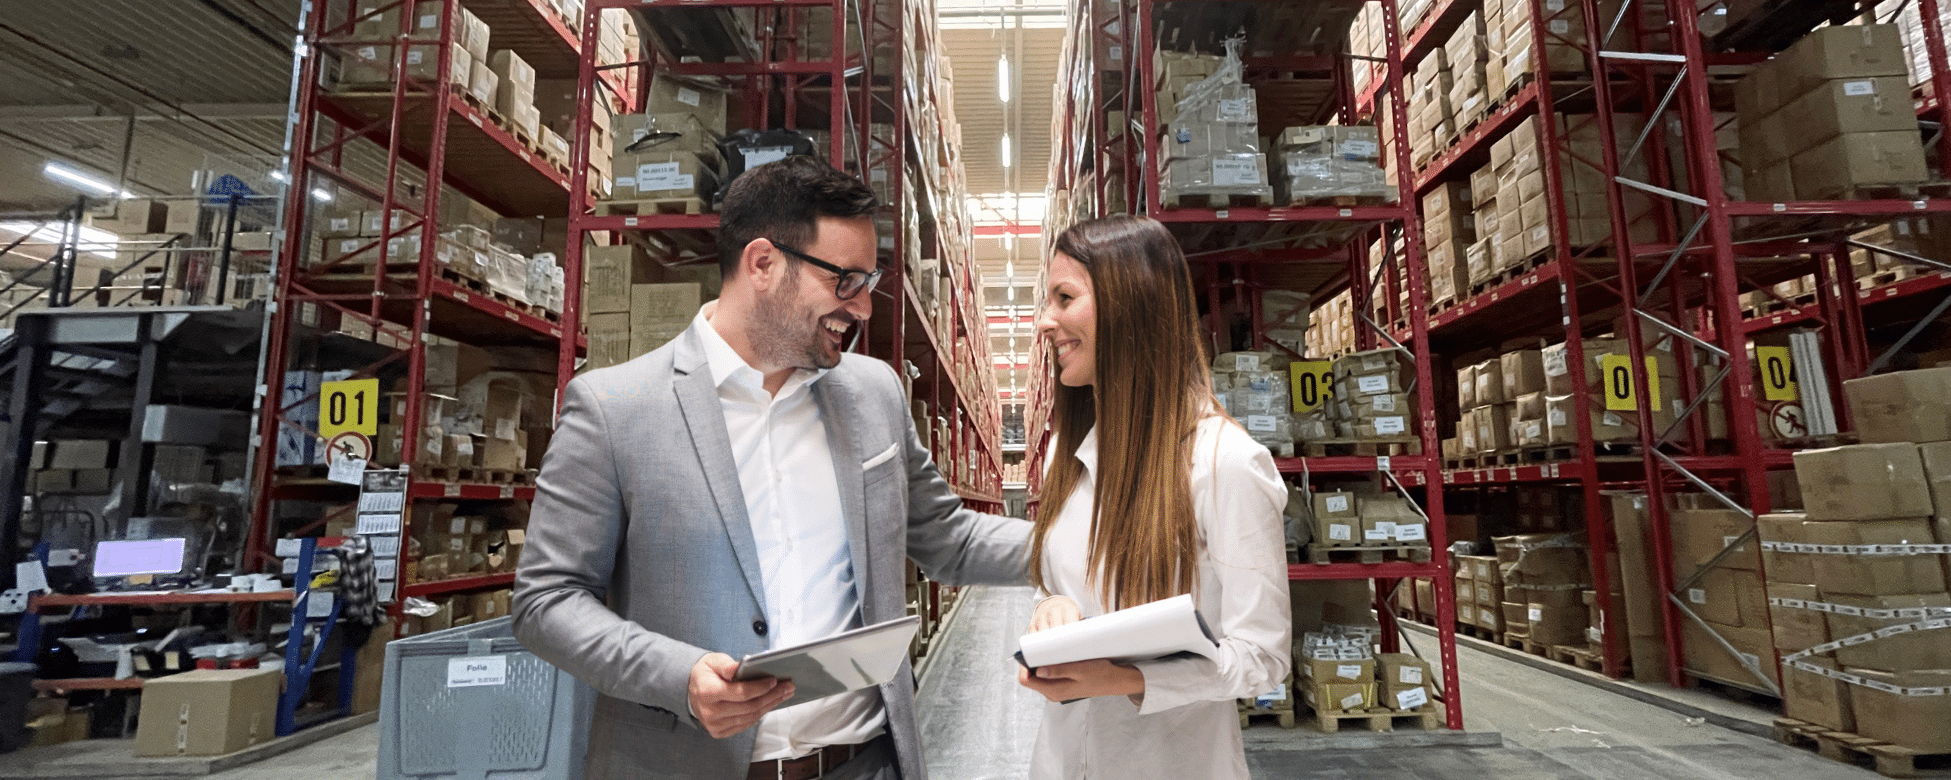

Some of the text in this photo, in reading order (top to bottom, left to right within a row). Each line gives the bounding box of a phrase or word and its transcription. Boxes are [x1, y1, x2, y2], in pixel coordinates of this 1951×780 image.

[1300, 372, 1336, 406] 03
[329, 390, 365, 426] 01
[466, 664, 488, 672] Folie
